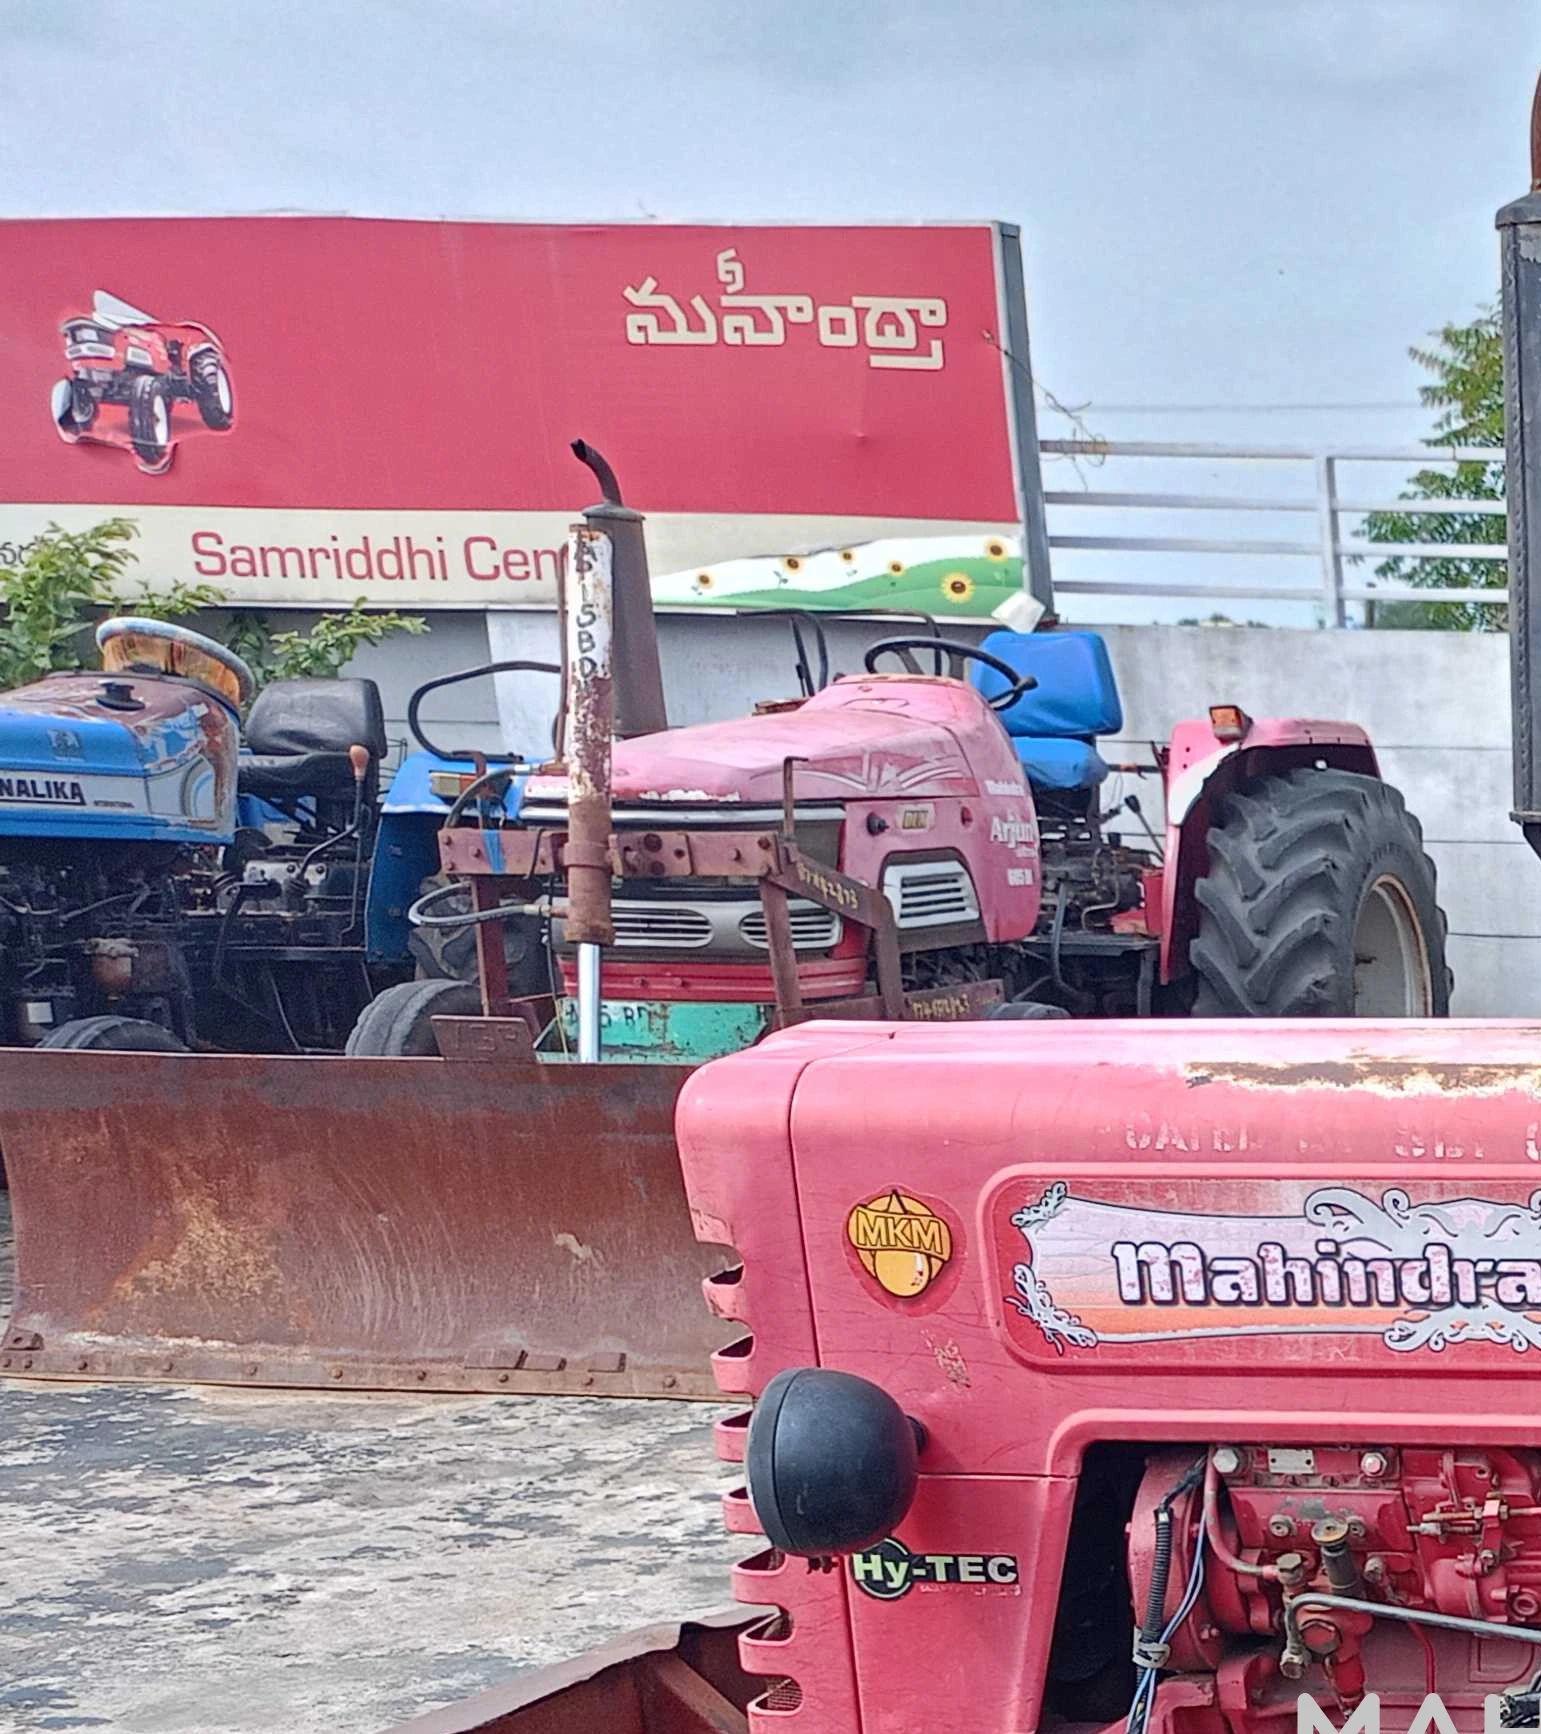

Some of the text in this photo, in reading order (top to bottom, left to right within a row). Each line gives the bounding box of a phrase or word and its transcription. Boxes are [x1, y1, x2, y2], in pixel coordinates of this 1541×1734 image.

[191, 531, 449, 582] Samriddhi
[855, 1209, 944, 1256] MKM
[852, 1552, 1018, 1589] Hy-TEC
